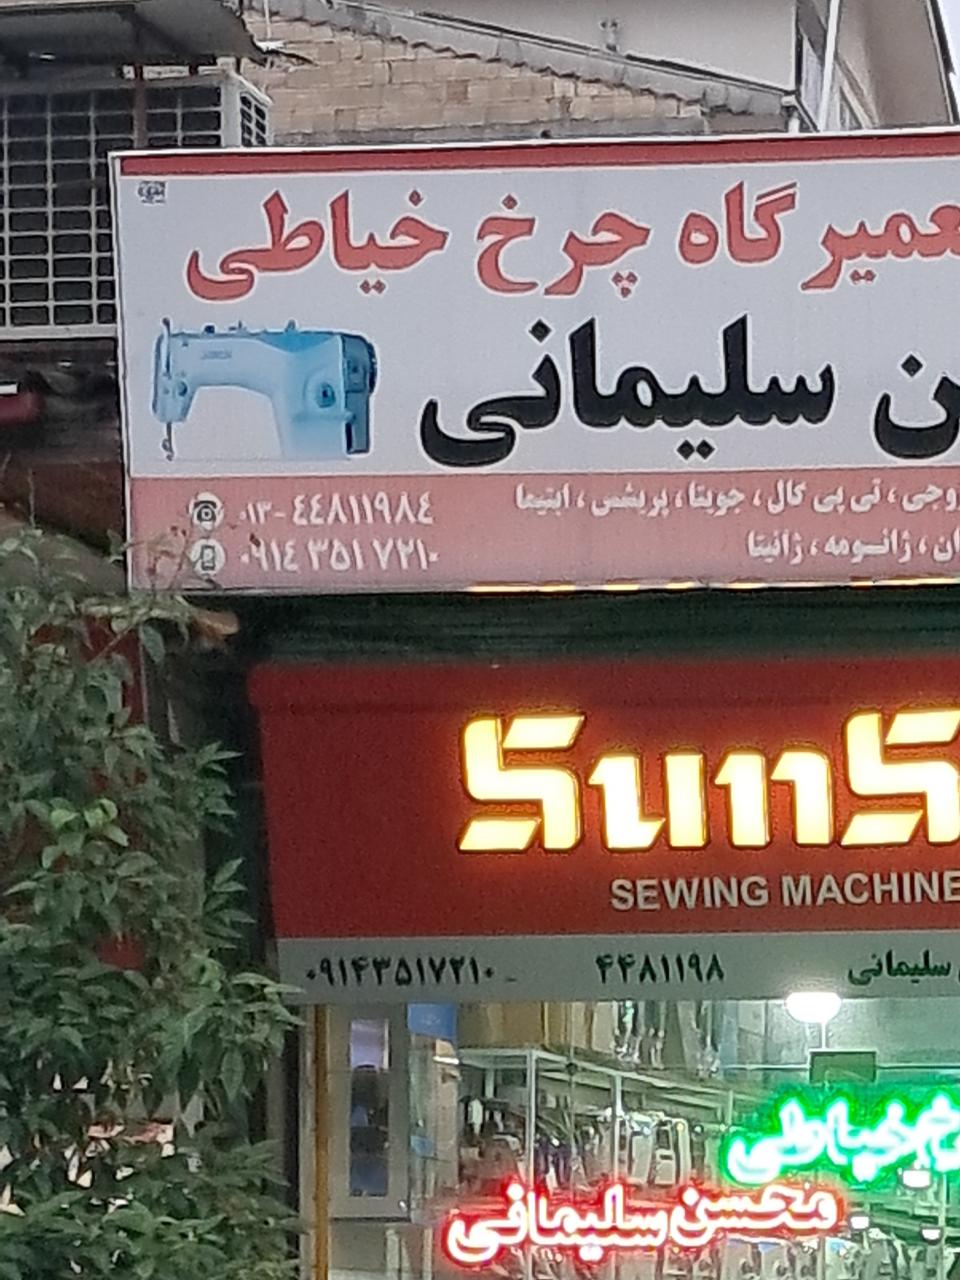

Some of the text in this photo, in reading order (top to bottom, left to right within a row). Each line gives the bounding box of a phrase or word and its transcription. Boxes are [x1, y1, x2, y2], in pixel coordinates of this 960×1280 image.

[186, 188, 449, 302] خیاطی
[477, 194, 651, 298] چرخ
[420, 312, 836, 468] سلیمانی
[610, 877, 769, 911] SEWING
[848, 948, 952, 986] سلیمانی
[726, 1097, 916, 1184] خیاطی
[447, 1182, 838, 1263] محسن سلیمانی
